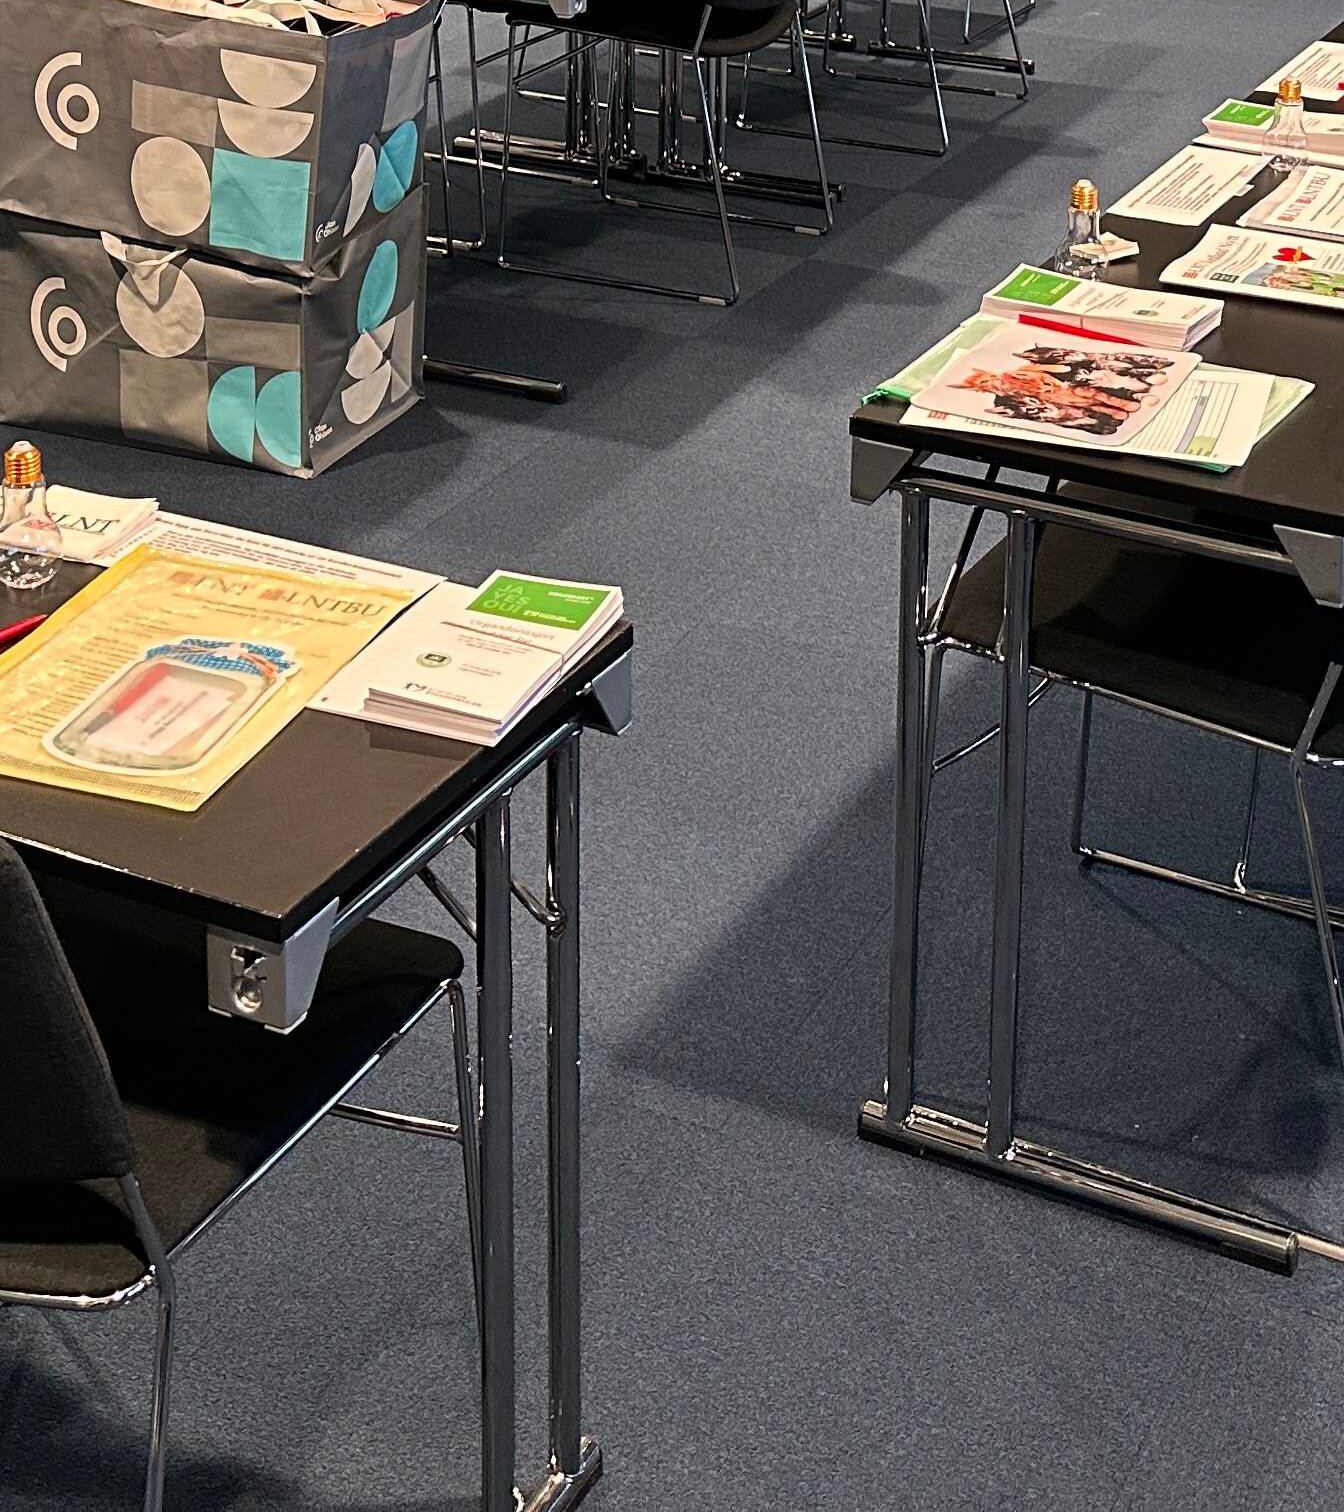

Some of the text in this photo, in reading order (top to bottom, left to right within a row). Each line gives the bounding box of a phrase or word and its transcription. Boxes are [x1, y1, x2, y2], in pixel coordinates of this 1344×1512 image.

[54, 513, 121, 533] LNT
[498, 585, 524, 596] JA
[283, 592, 387, 616] LNTBU
[492, 591, 532, 606] YES
[483, 600, 523, 614] OUI
